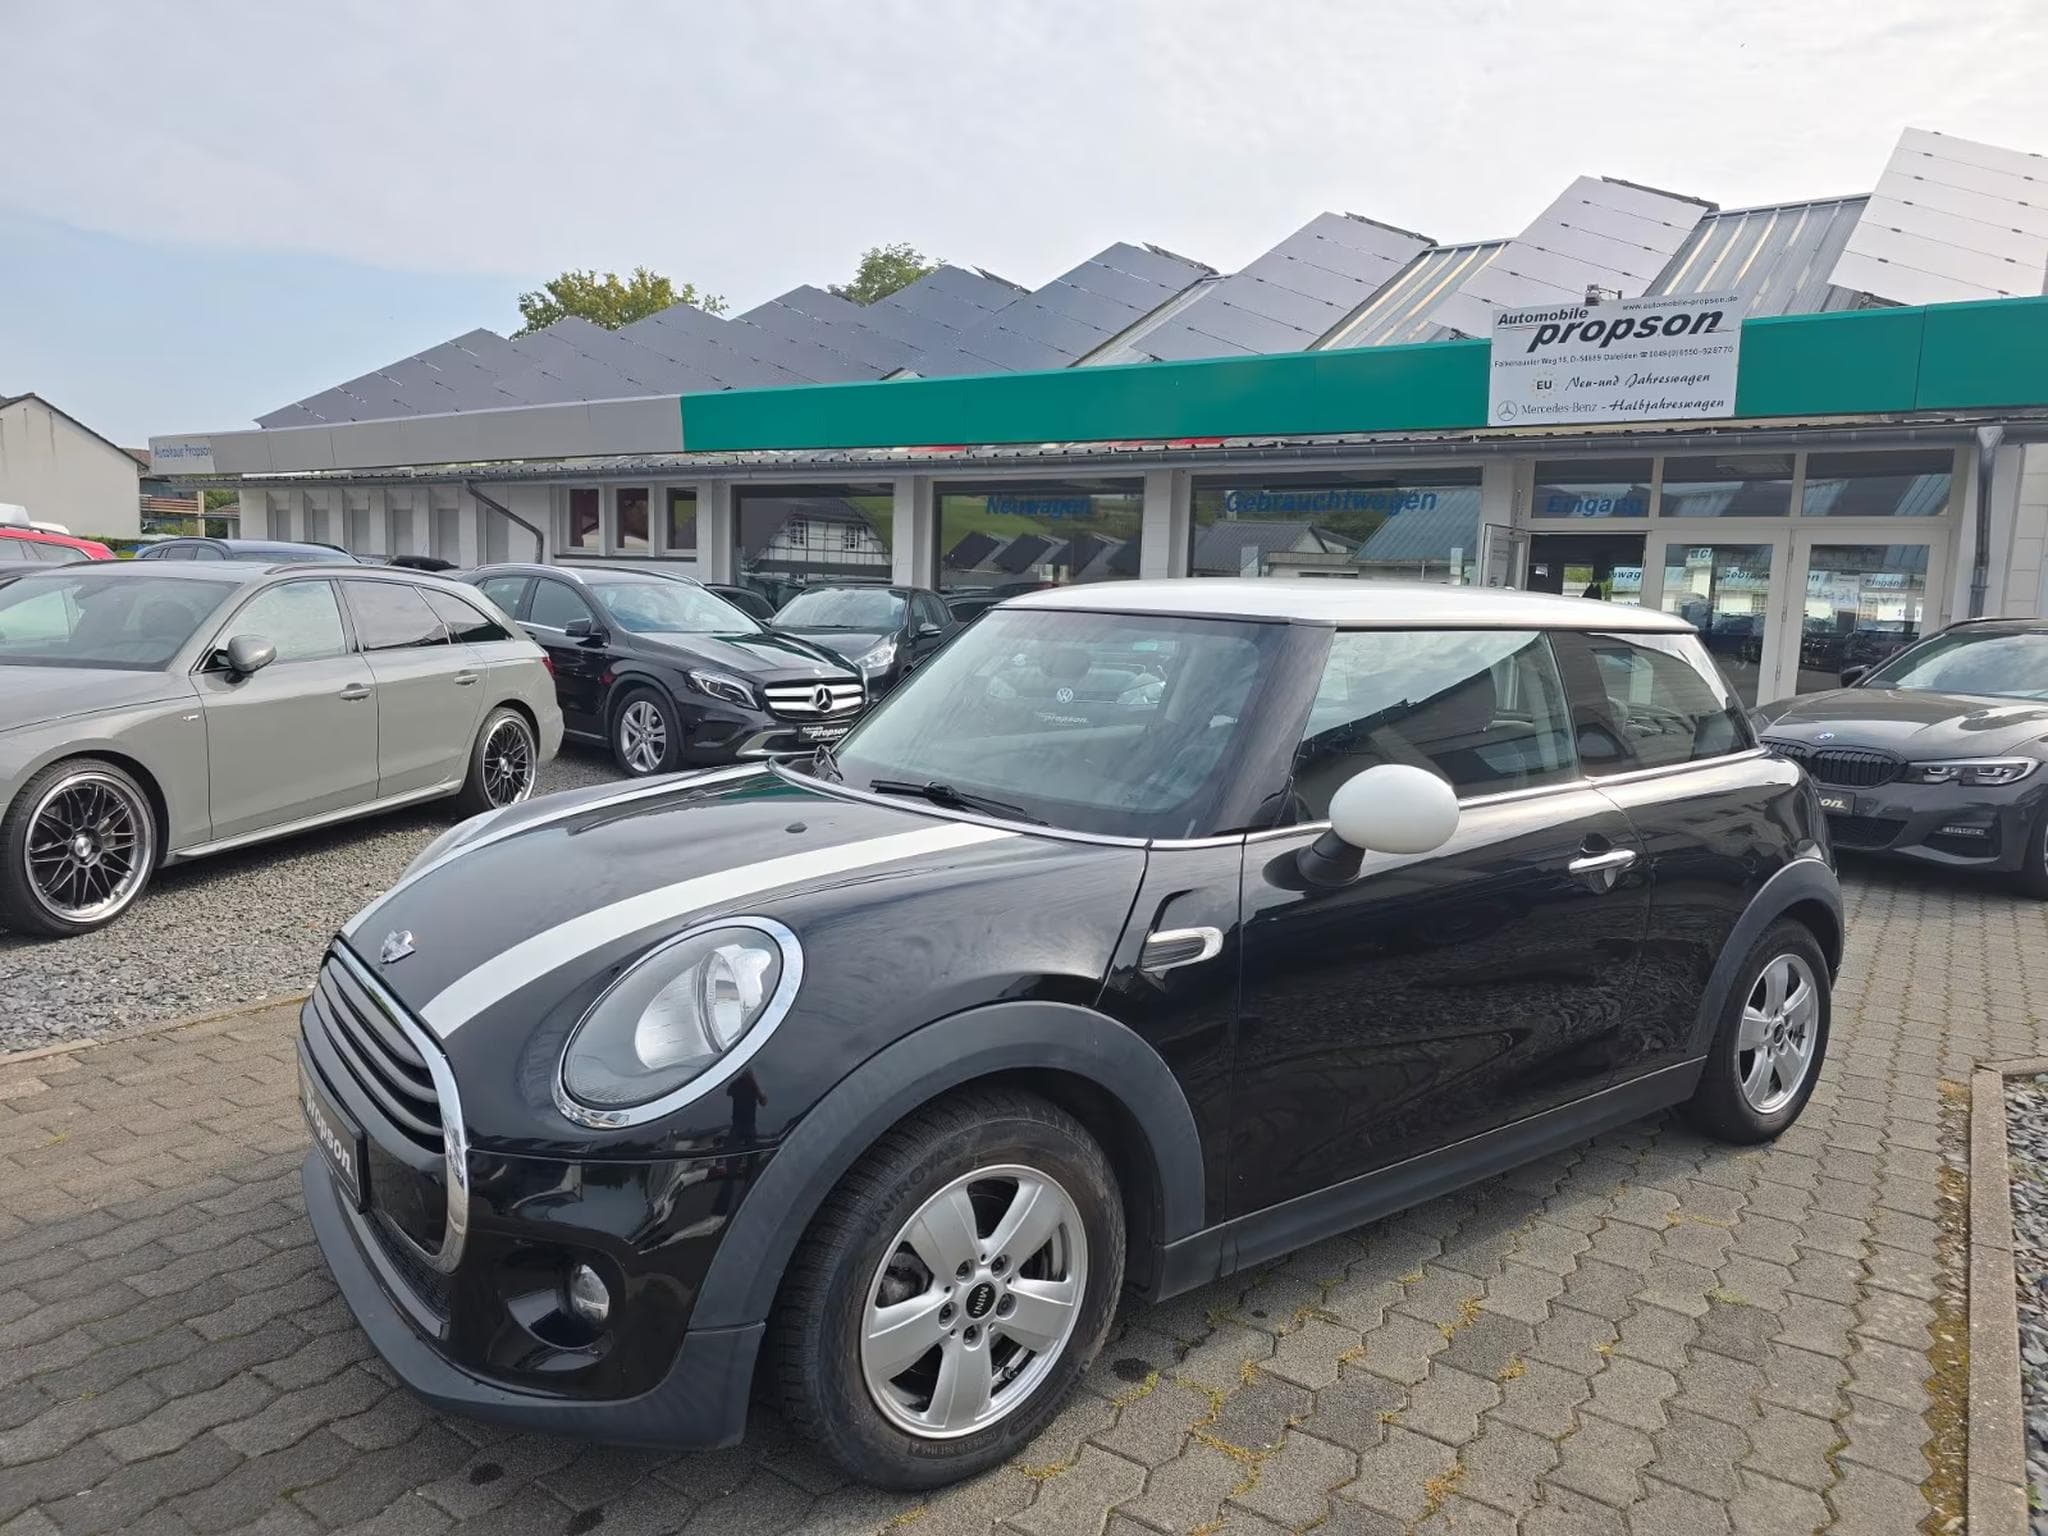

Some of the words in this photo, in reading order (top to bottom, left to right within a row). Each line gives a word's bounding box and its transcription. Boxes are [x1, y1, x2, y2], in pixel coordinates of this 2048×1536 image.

[1497, 307, 1589, 325] Automobile
[1526, 310, 1724, 353] propson
[1536, 380, 1553, 390] EU
[1624, 373, 1710, 388] Jahreswagen
[1520, 402, 1598, 415] Mercedes-Benz
[985, 495, 1089, 519] Neuwagen
[1226, 489, 1438, 516] Gebrauchtwagen
[1546, 495, 1643, 517] Eingang
[973, 1286, 989, 1315] MINI
